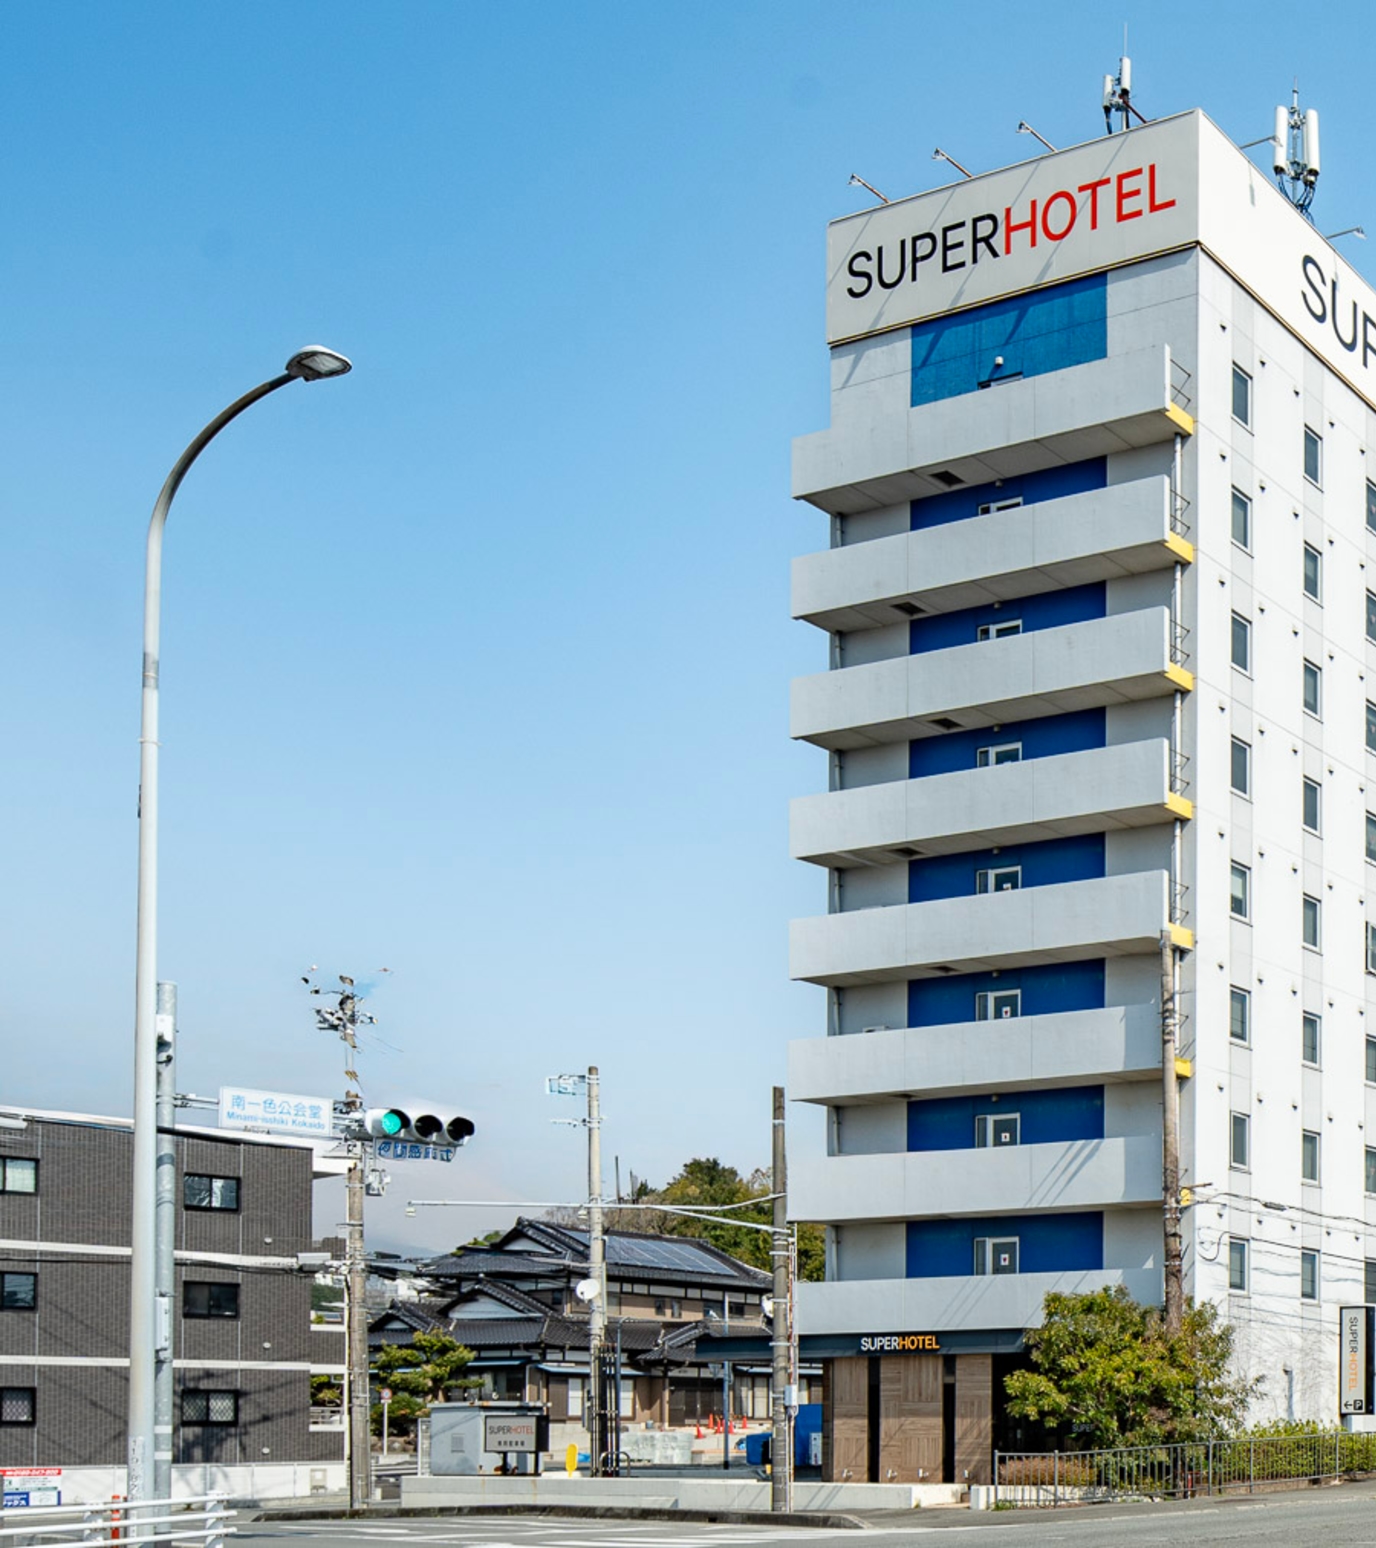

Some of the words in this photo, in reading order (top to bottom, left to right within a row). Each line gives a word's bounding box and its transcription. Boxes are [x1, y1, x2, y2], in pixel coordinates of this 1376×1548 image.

[846, 163, 1176, 299] SUPERHOTEL
[231, 1094, 323, 1119] 南一色公会堂
[226, 1111, 288, 1126] Minami-isshiki
[860, 1335, 940, 1351] SUPERHOTEL
[1349, 1316, 1359, 1391] SUPERHOTEL
[489, 1425, 534, 1435] SUPERHOTEL
